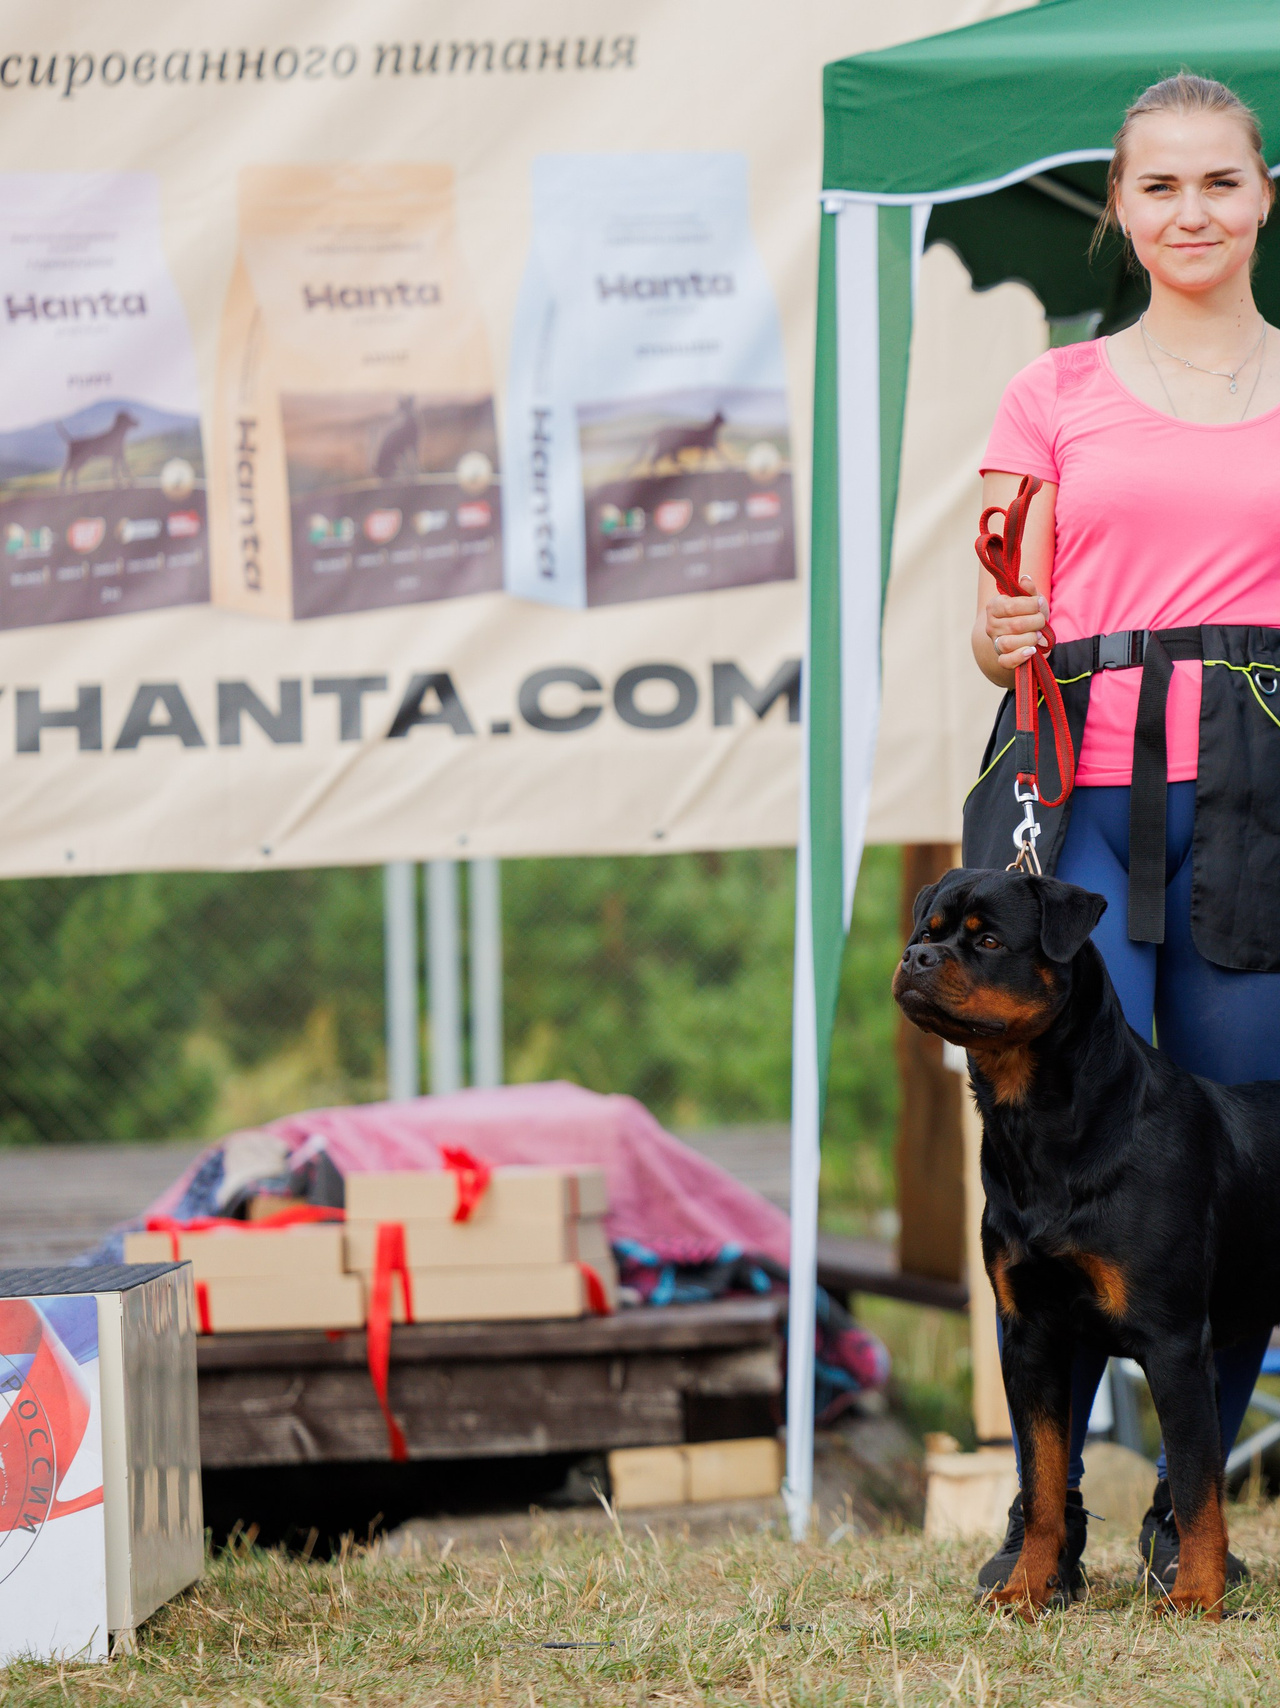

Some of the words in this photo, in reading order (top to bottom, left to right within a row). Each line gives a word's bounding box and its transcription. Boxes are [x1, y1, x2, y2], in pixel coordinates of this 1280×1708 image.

[0, 44, 360, 100] сированного
[373, 34, 637, 76] питания
[6, 290, 149, 323] Hanta
[303, 281, 442, 312] Hanta
[596, 271, 736, 303] Hanta
[235, 418, 264, 593] Hanta
[530, 408, 557, 581] Hanta
[0, 658, 802, 754] HANTA.COM
[1, 1374, 51, 1534] РОССИИ
